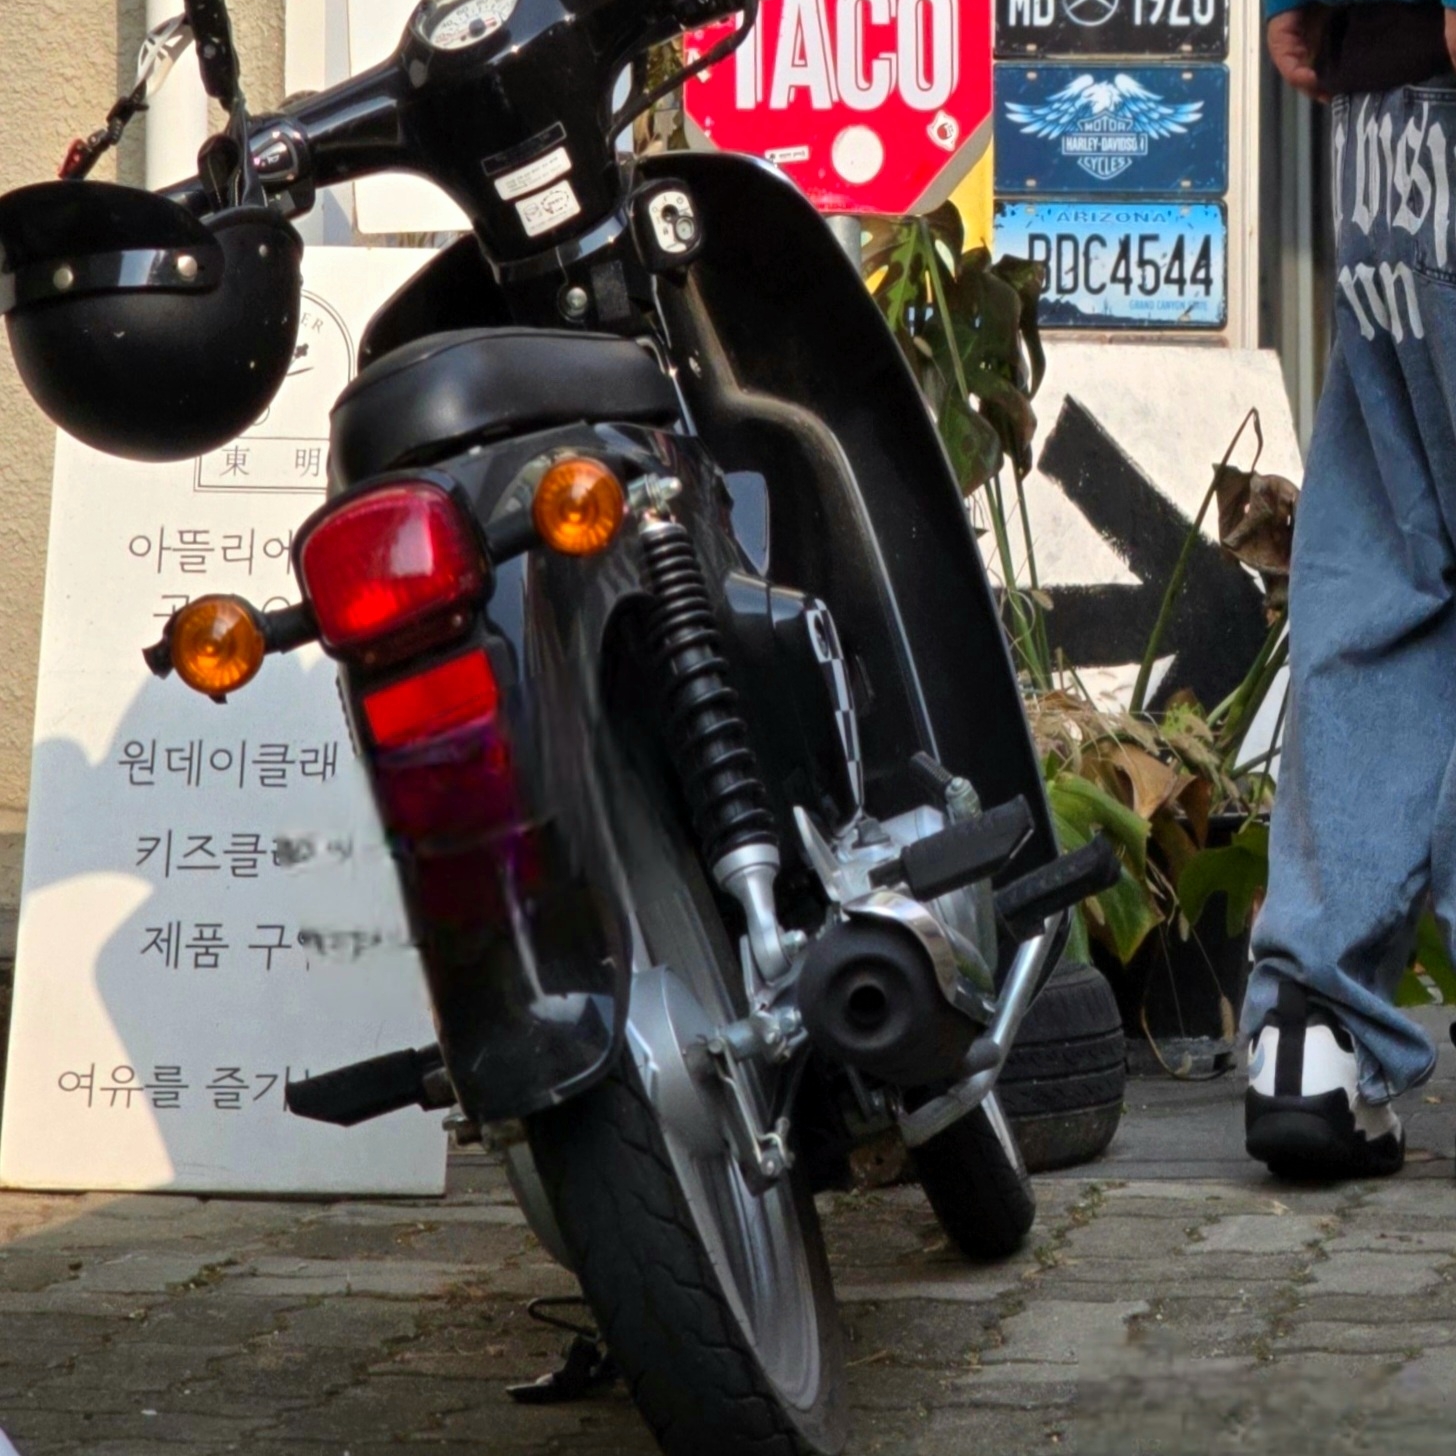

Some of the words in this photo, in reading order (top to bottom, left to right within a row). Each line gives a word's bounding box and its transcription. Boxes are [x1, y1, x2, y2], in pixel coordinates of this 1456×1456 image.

[1084, 118, 1127, 132] MOTOR
[1082, 156, 1126, 175] CYCLES
[1056, 210, 1167, 224] ARIZONA
[1028, 232, 1214, 297] BDC4544
[135, 829, 284, 878] 키즈클
[140, 920, 230, 970] 제품
[247, 924, 309, 972] 구
[57, 1062, 190, 1110] 여유를
[205, 1065, 310, 1113] 즐기
